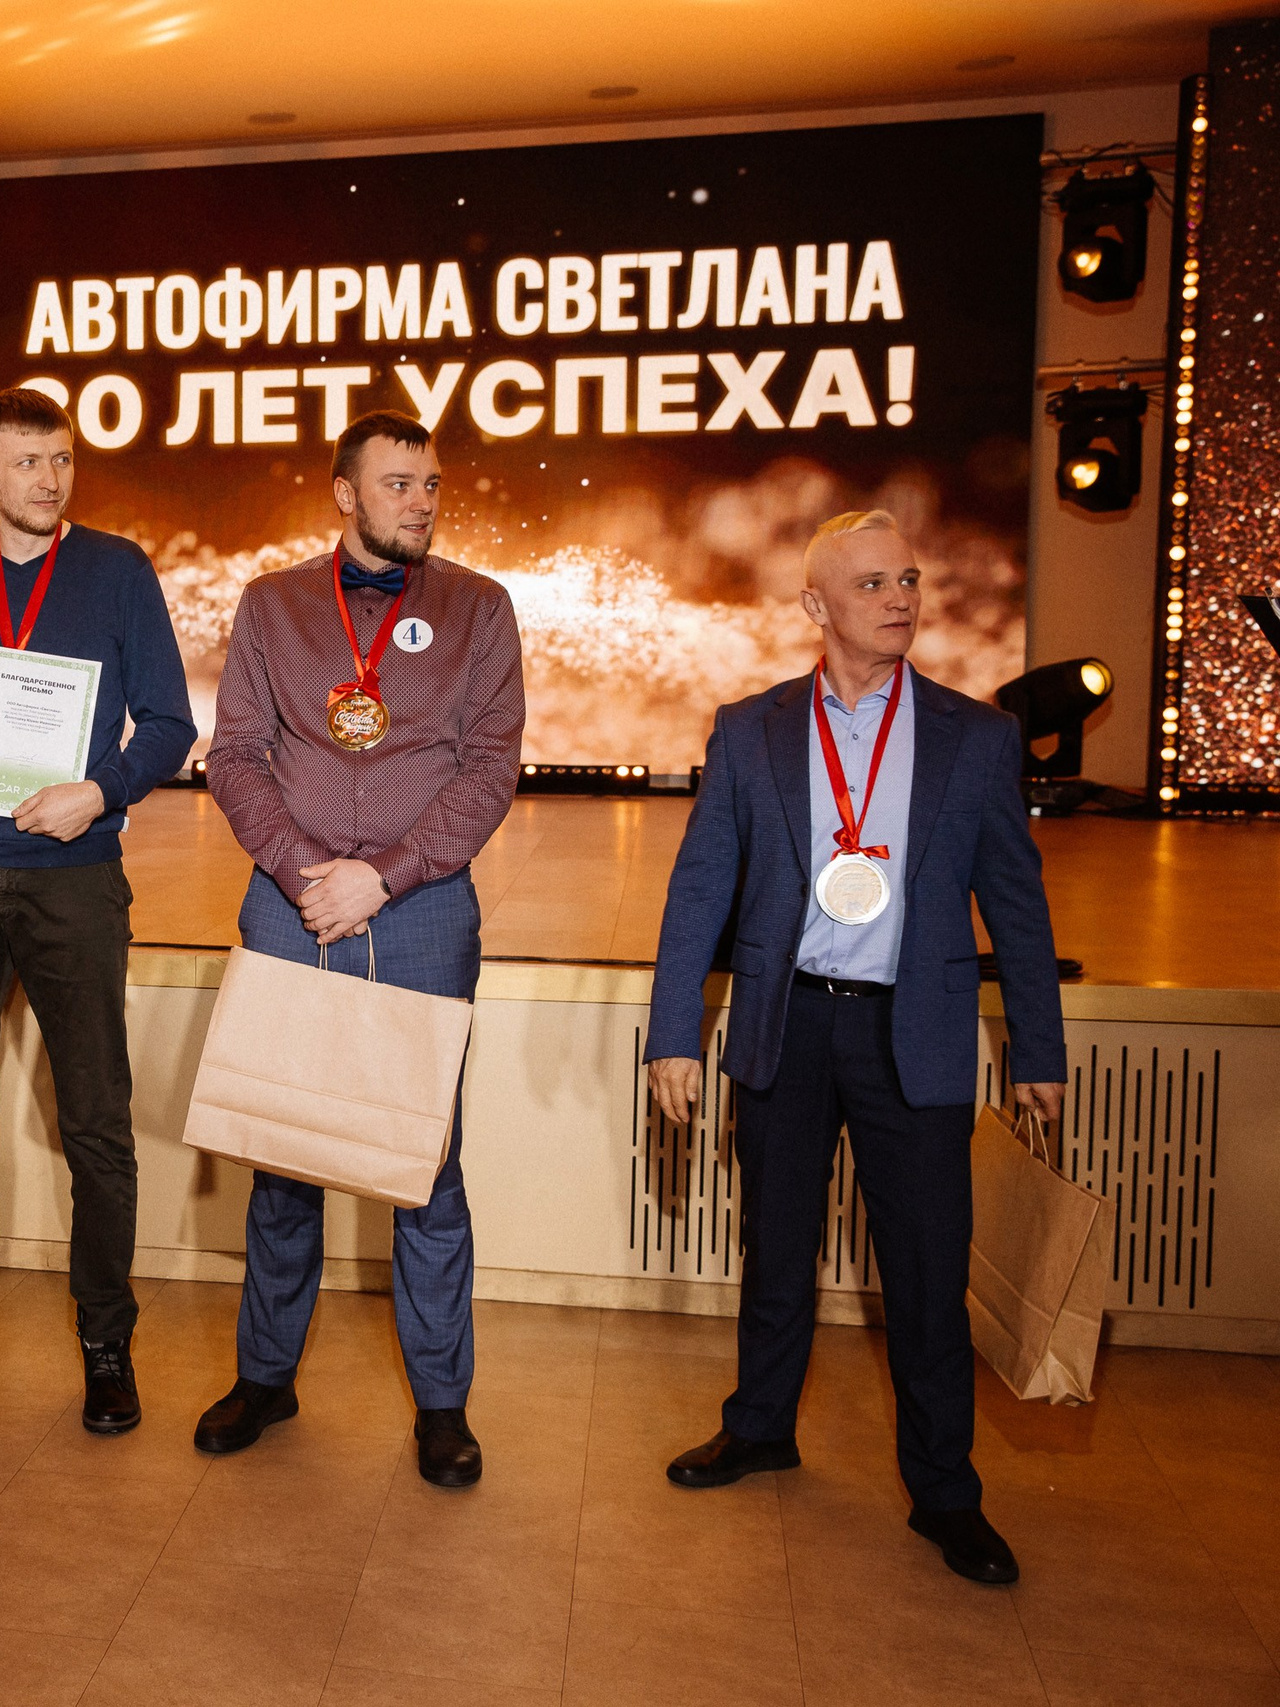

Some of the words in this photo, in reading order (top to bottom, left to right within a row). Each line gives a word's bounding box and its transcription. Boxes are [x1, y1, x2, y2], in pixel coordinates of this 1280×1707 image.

[25, 262, 471, 355] АВТОФИРМА
[495, 240, 903, 335] СВЕТЛАНА
[166, 366, 371, 446] ЛЕТ
[394, 345, 916, 438] УСПЕХА!
[402, 622, 422, 645] 4
[1, 673, 77, 691] БЛАГОДАРСТВЕННОЕ
[21, 685, 53, 695] ПИСЬМО
